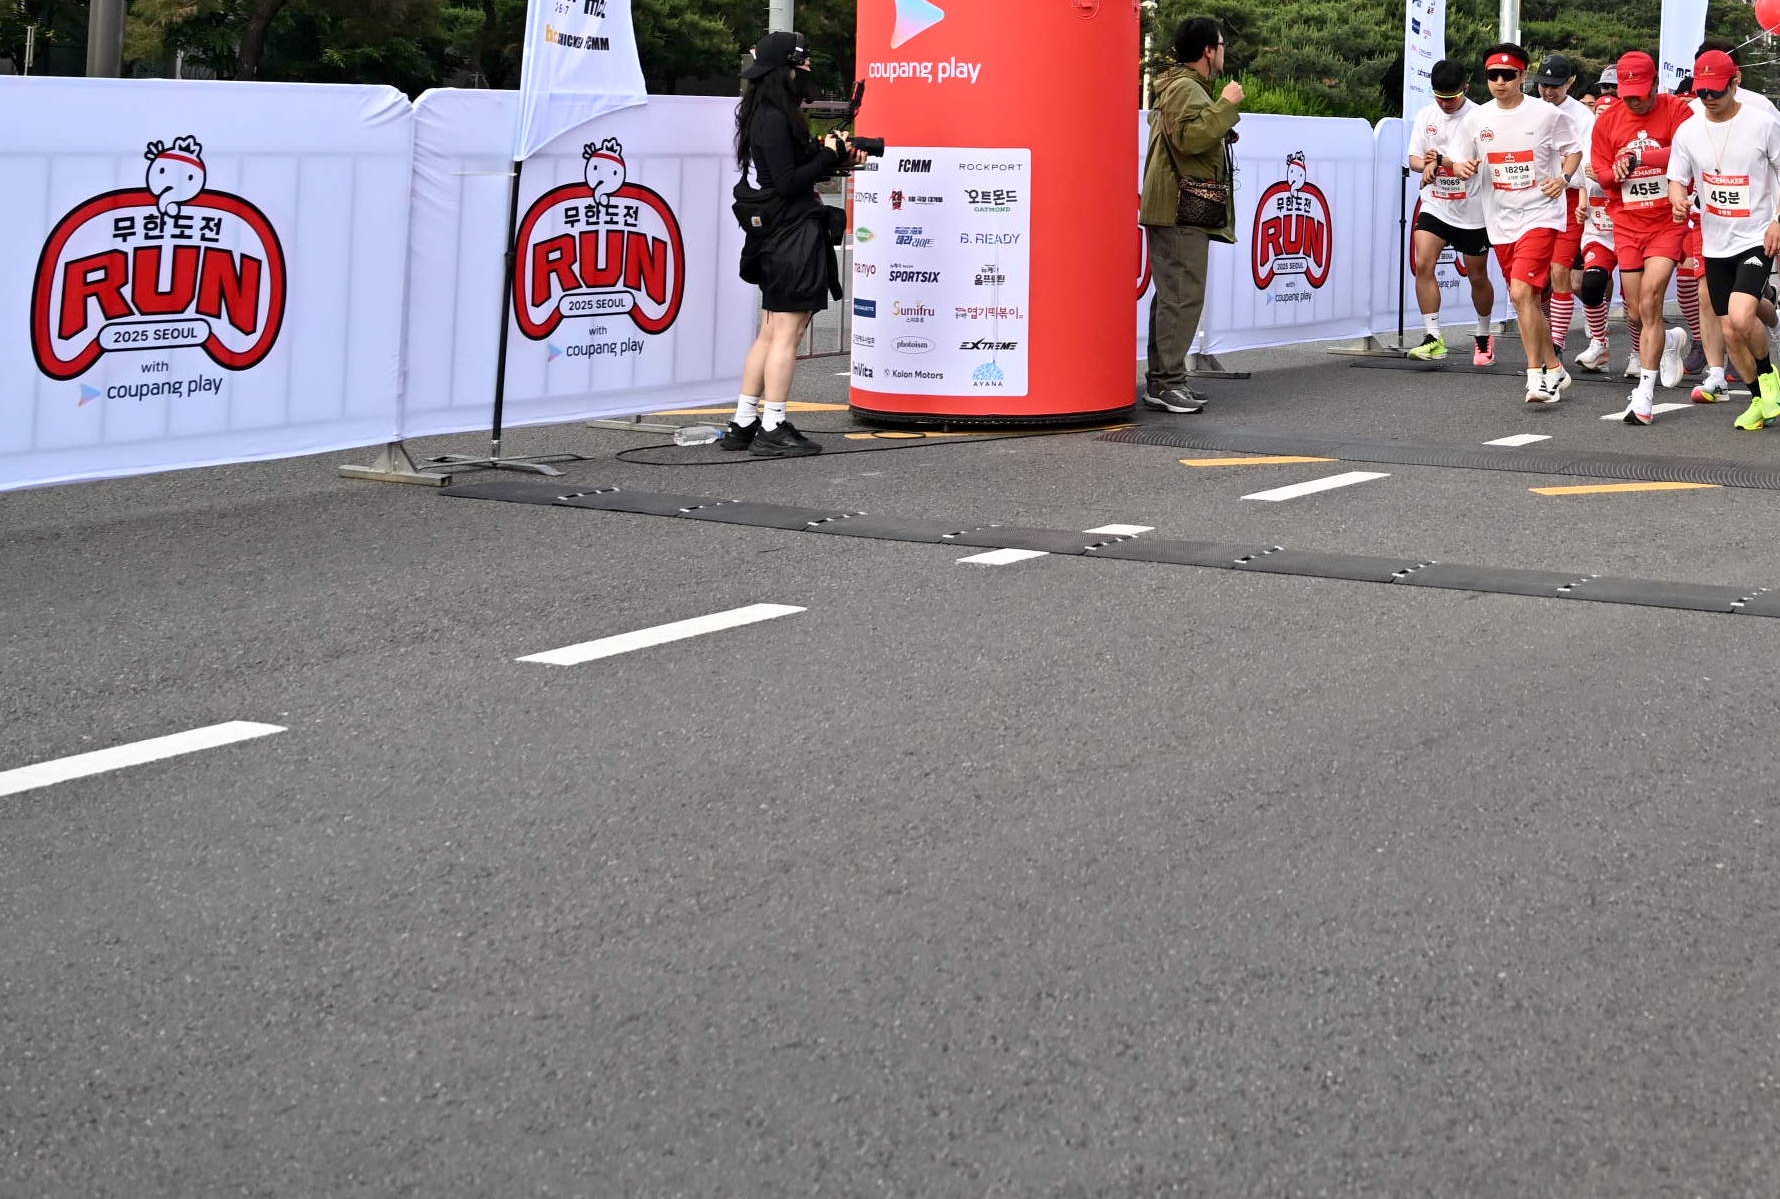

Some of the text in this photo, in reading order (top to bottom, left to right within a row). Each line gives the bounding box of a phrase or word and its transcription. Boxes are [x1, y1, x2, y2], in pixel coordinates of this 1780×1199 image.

[868, 57, 982, 84] coupang play
[898, 159, 932, 173] FCMM
[959, 163, 1023, 171] ROCKPORT
[1504, 165, 1530, 174] 18294
[1630, 168, 1662, 177] CEMAKER
[1630, 181, 1661, 196] 45분
[964, 189, 1018, 206] 오트몬드
[1276, 196, 1312, 213] 무한도전
[1711, 191, 1740, 204] 45분
[564, 204, 639, 228] 무한도전
[112, 213, 222, 243] 무한도전
[975, 234, 1021, 244] READY
[1260, 214, 1325, 268] RUN
[531, 229, 667, 308] RUN
[889, 270, 941, 283] SPORTSIX
[58, 244, 262, 341] RUN
[568, 298, 626, 311] 2025 SEOUL
[893, 301, 935, 316] Sumifru
[113, 327, 198, 343] 2025 SEOUL
[589, 325, 608, 336] with
[566, 337, 645, 359] coupang play
[896, 340, 928, 351] photoism
[959, 338, 1018, 350] EXTREME
[141, 361, 169, 373] with
[892, 369, 944, 380] Kolon Motors
[107, 375, 223, 401] coupang play
